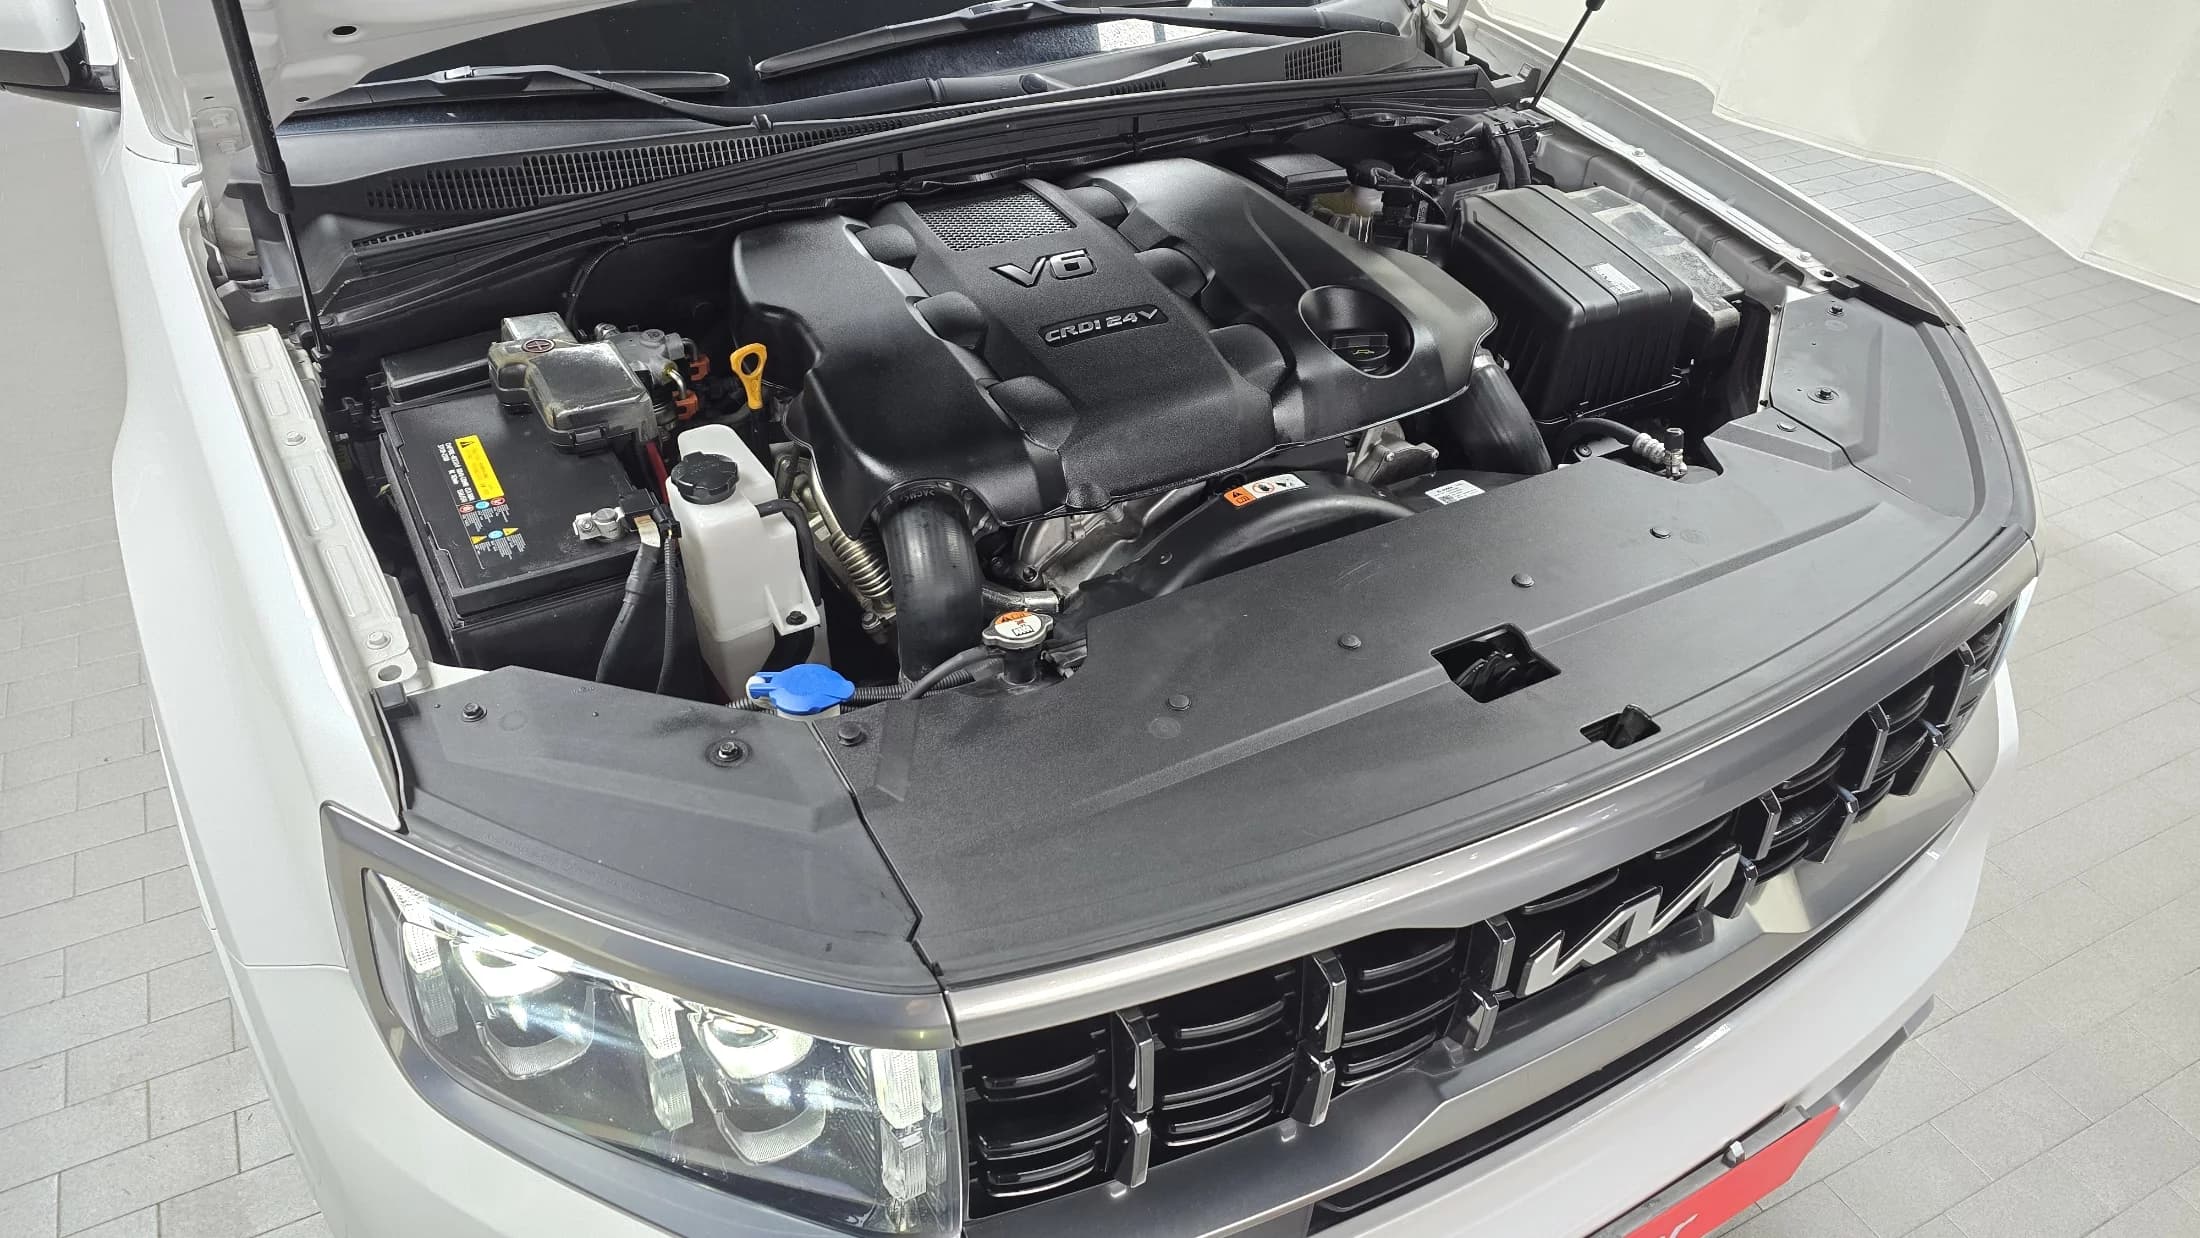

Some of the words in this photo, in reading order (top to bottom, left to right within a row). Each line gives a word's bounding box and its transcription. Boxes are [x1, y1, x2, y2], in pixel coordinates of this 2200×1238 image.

[990, 248, 1097, 288] V6
[1105, 308, 1158, 327] 24V
[1517, 847, 1741, 997] KIA
